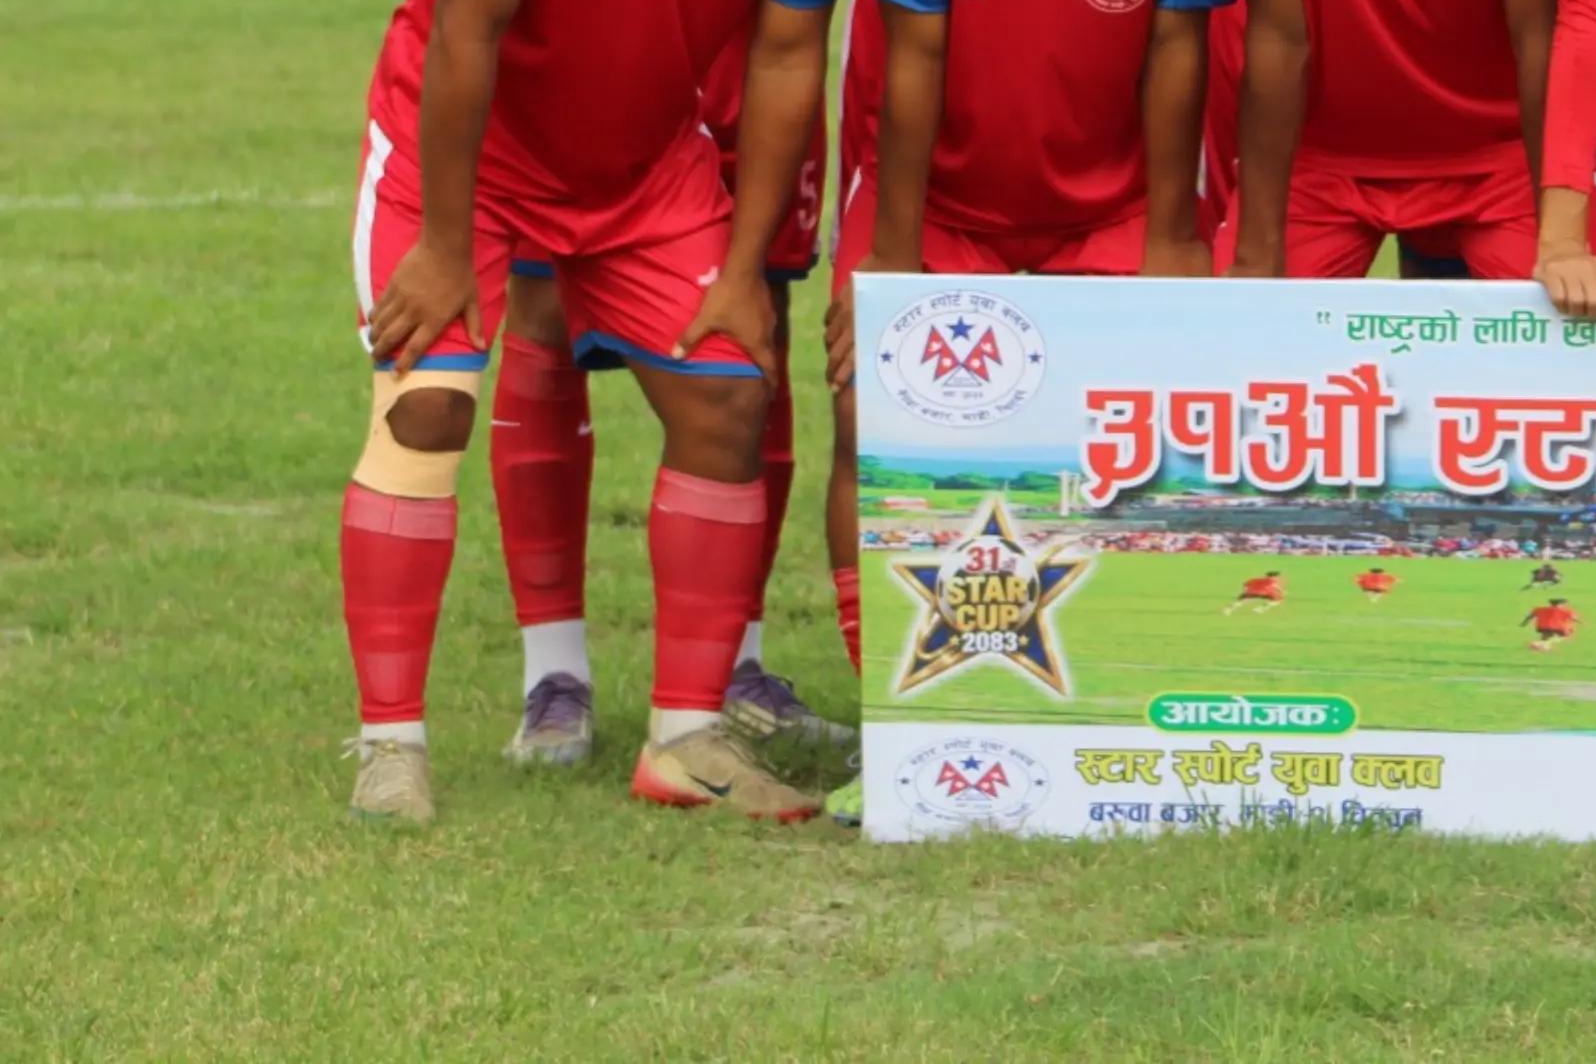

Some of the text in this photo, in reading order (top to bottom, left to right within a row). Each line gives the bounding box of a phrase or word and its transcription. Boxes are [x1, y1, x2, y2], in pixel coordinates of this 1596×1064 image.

[1346, 309, 1460, 354] राष्ट्रको
[1473, 311, 1550, 345] लागि
[947, 575, 1027, 604] STAR
[955, 604, 1021, 631] CUP
[961, 632, 1018, 652] 2083
[1075, 748, 1164, 784] स्टार
[1172, 740, 1263, 786] स्पोर्ट
[1270, 751, 1343, 796] युवा
